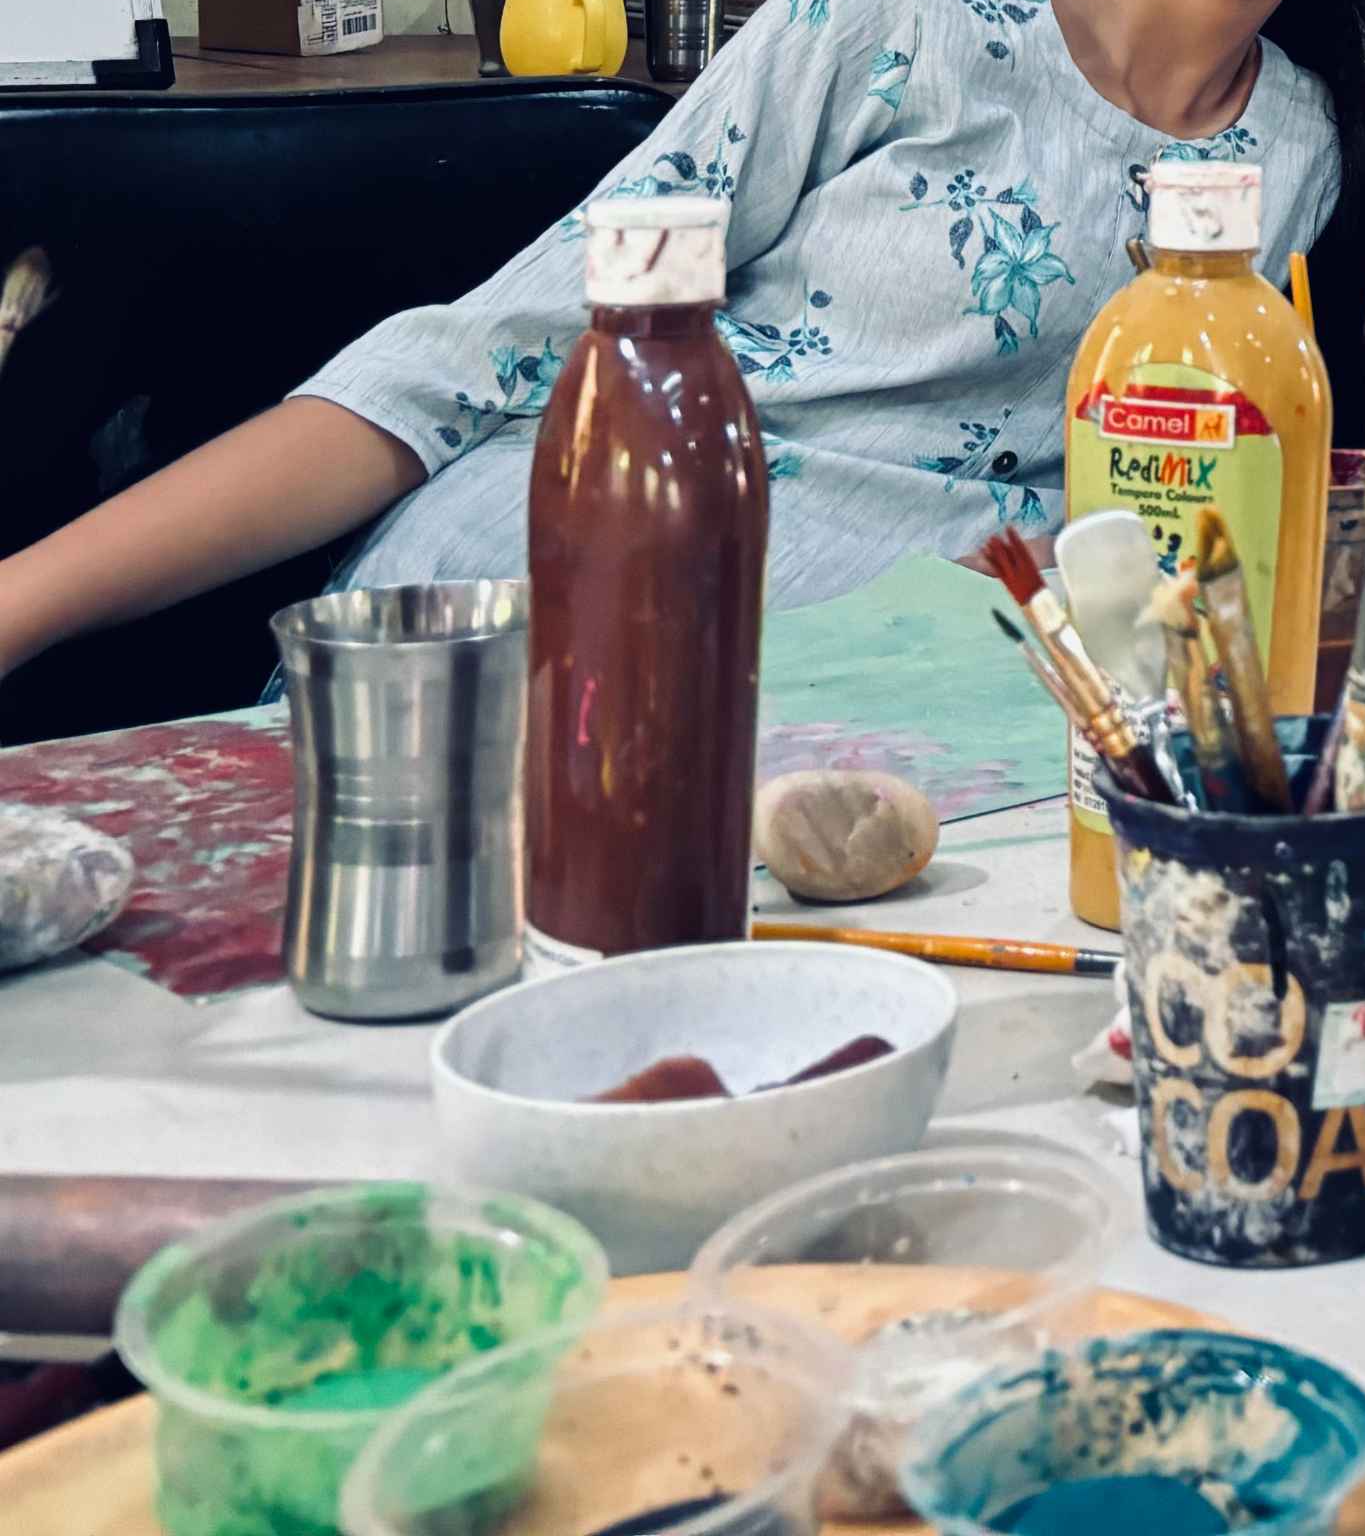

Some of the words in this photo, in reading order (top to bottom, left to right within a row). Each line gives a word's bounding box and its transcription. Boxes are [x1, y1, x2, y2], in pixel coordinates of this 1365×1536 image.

[1108, 407, 1190, 434] Camel
[1111, 483, 1162, 500] Tempera
[1166, 489, 1214, 504] Colours
[1144, 952, 1307, 1079] CO
